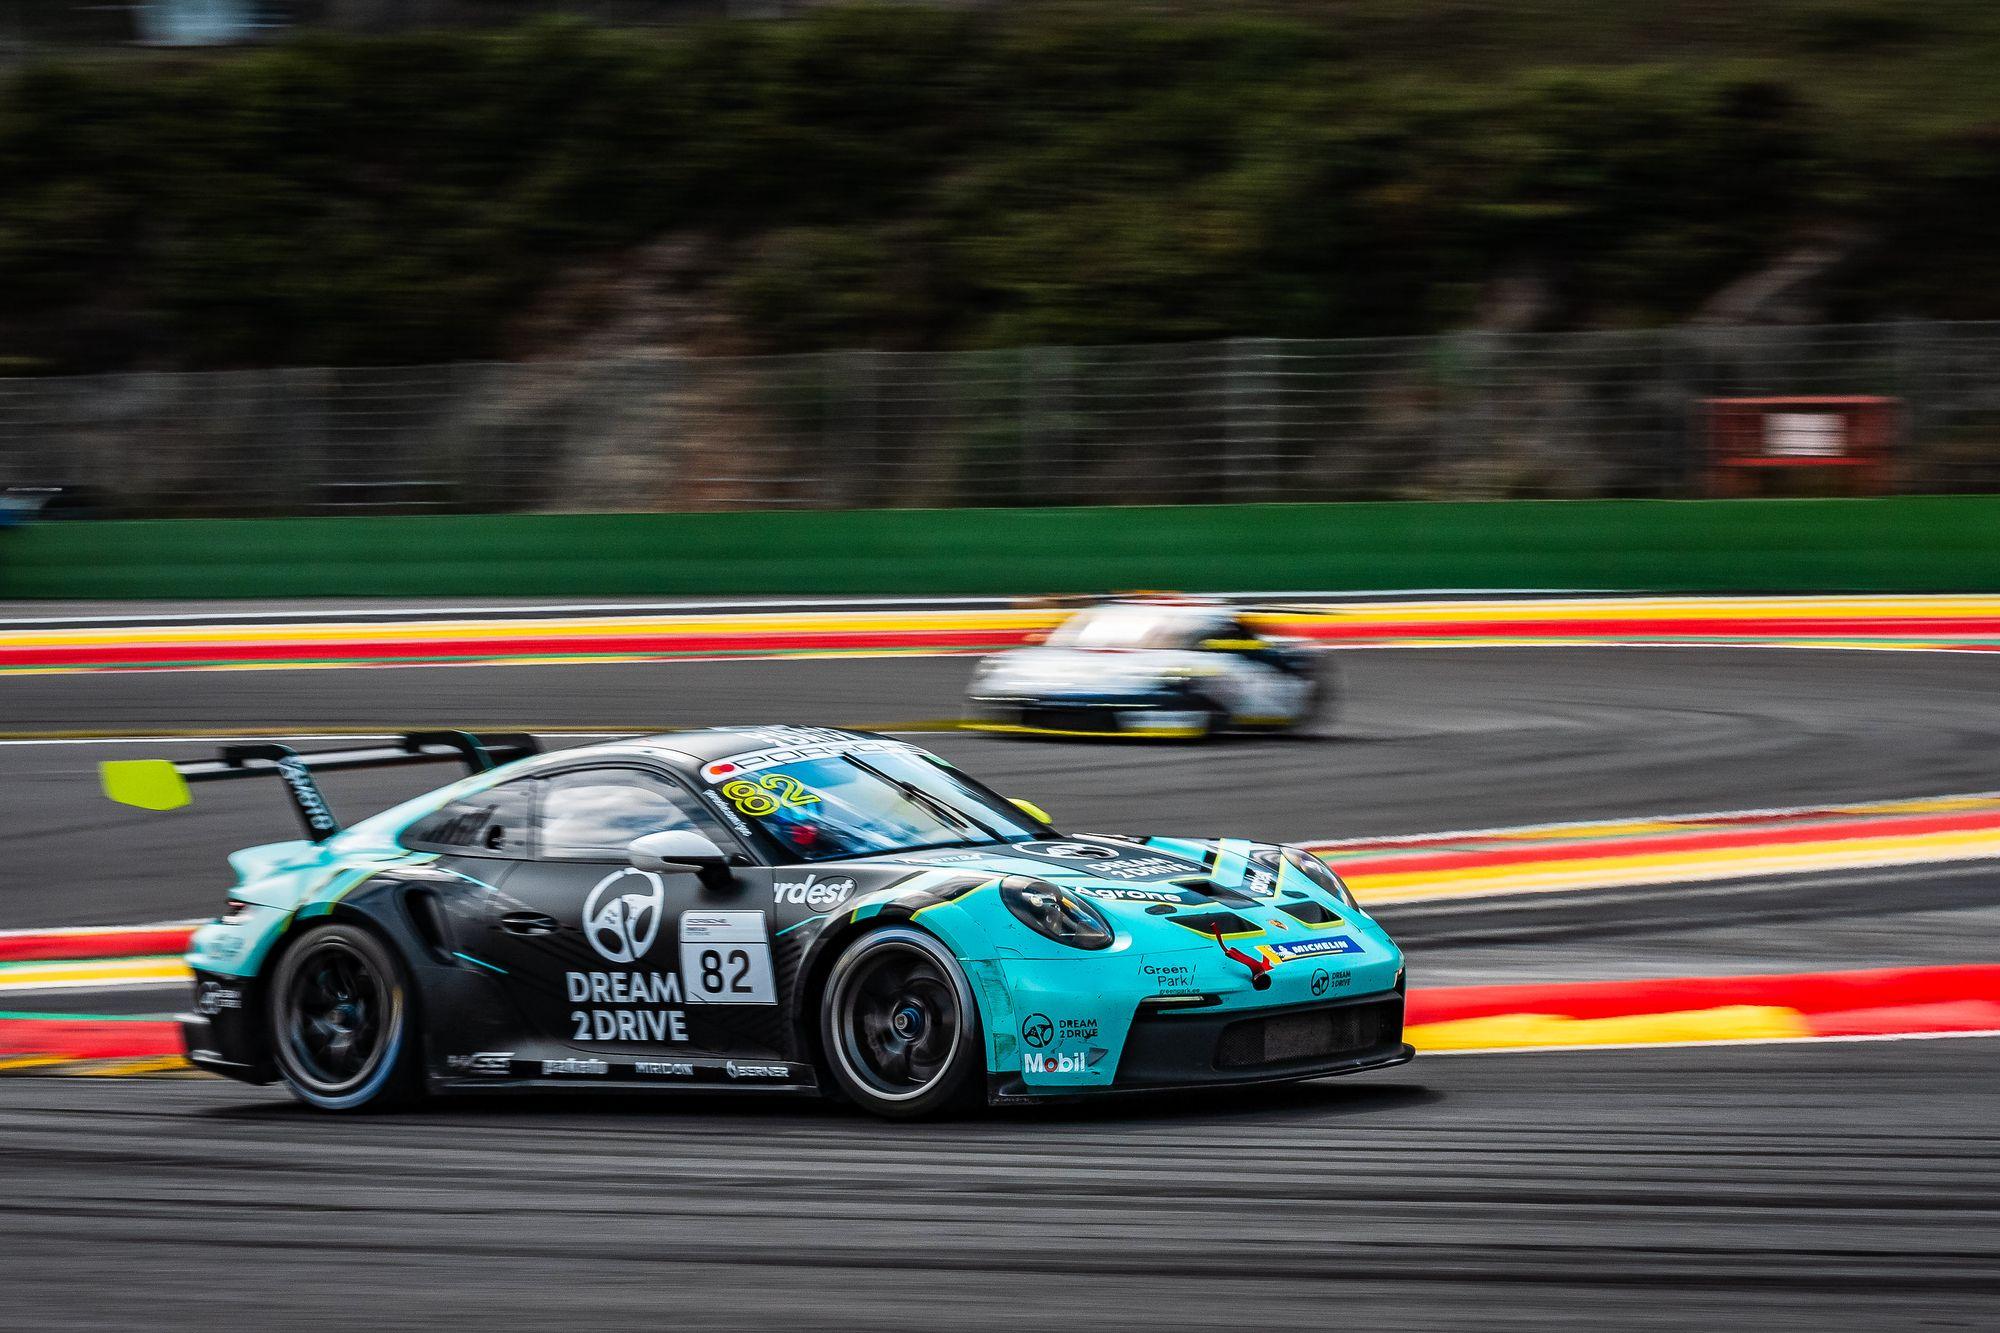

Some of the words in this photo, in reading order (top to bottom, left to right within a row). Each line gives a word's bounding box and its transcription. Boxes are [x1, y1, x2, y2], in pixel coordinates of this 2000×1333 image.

[722, 773, 821, 816] 82
[1291, 940, 1348, 953] MICHELIN
[701, 950, 754, 993] 82
[1143, 965, 1188, 975] Green
[1331, 971, 1351, 979] DREAM
[565, 971, 684, 1003] DREAM
[1158, 974, 1189, 987] Park
[571, 1010, 689, 1041] 2DRIVE
[1059, 1019, 1098, 1028] DREAM
[1060, 1029, 1098, 1039] 2DRIVE
[1024, 1052, 1085, 1073] Mobil
